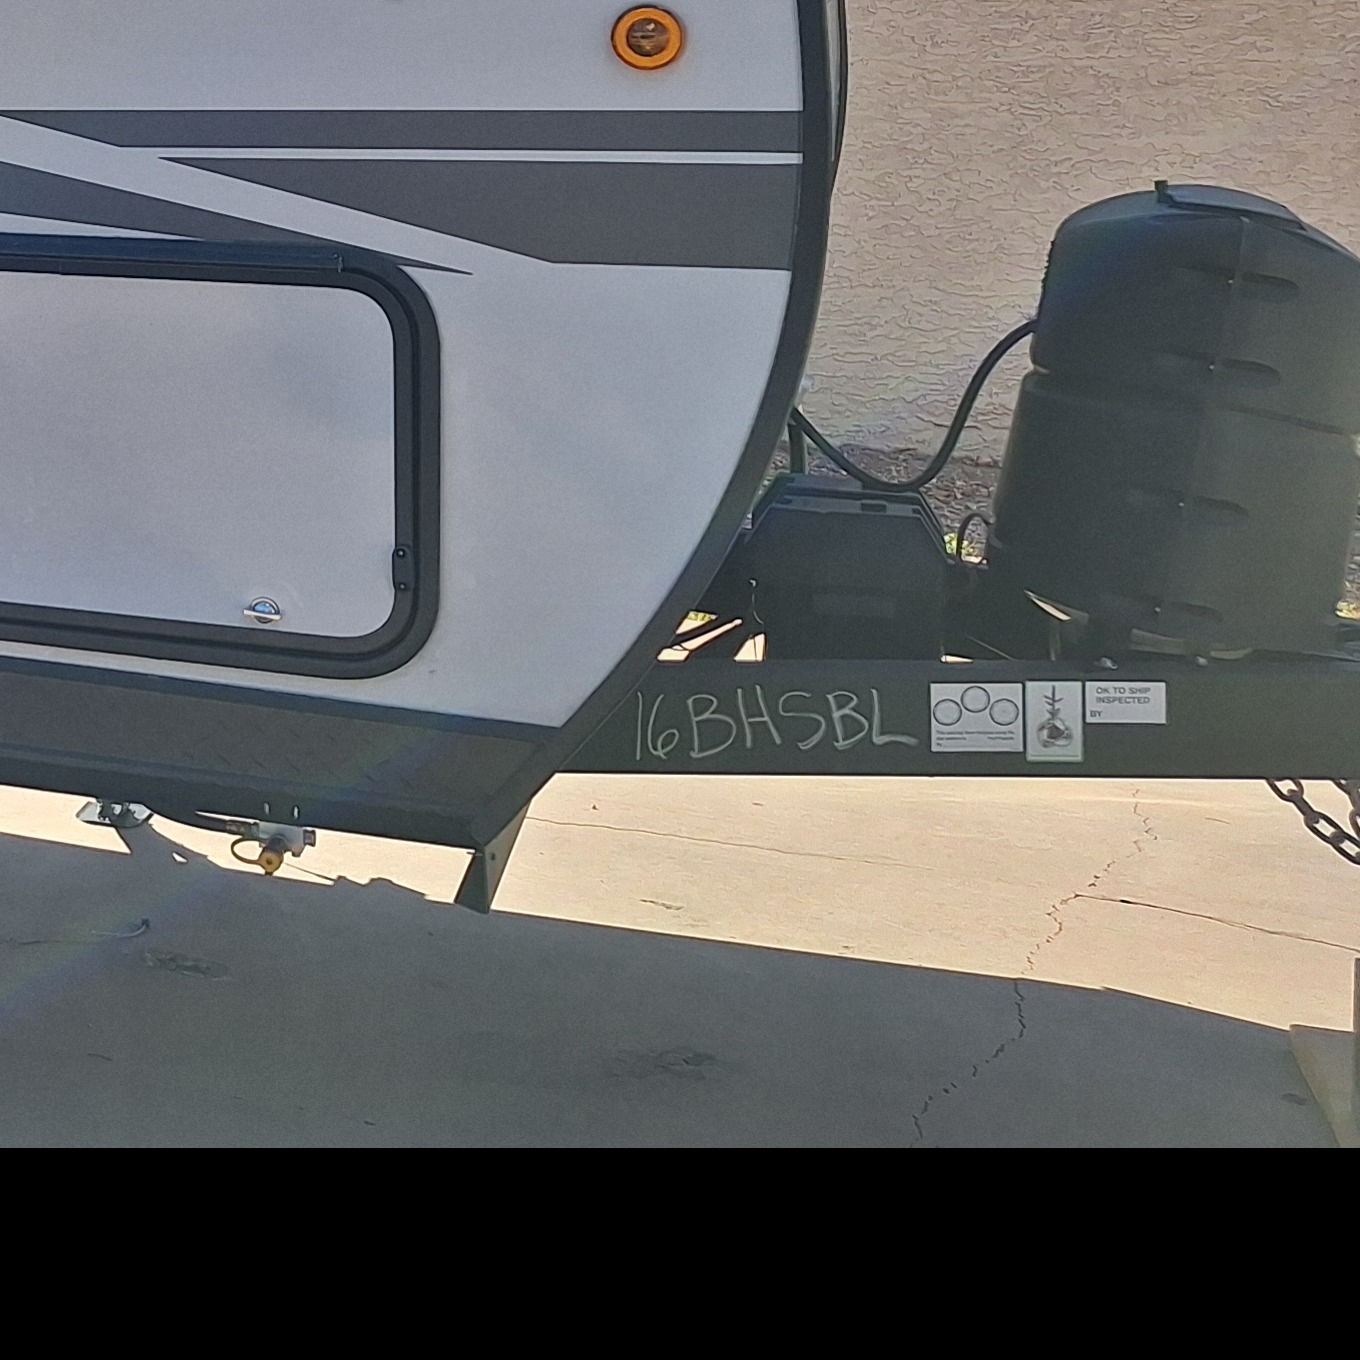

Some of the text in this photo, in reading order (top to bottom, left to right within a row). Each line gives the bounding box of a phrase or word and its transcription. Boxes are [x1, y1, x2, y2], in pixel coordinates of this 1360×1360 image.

[1095, 686, 1151, 695] OK TO SHIP
[1095, 696, 1151, 705] INSPECTED
[1089, 710, 1103, 718] BY
[635, 684, 920, 761] 16BHSBL
